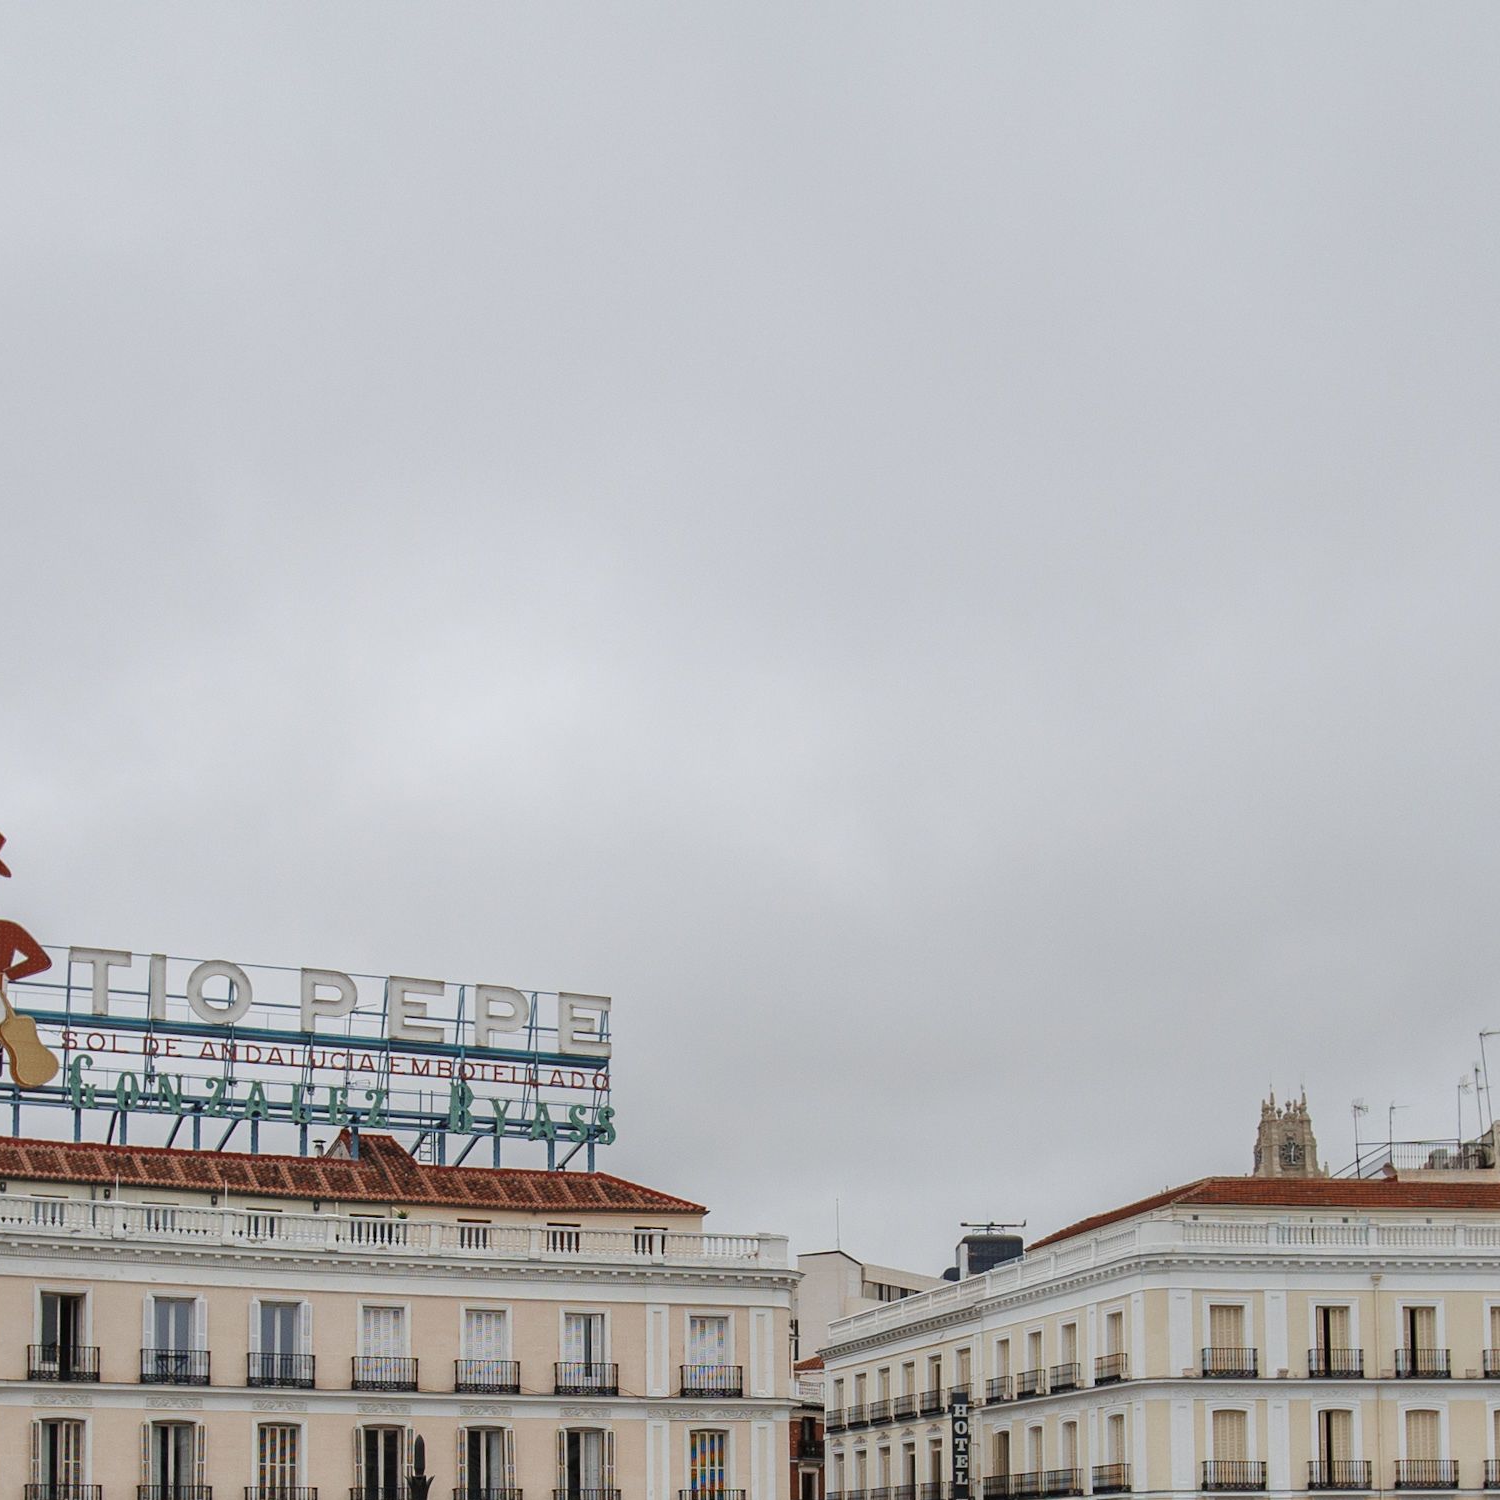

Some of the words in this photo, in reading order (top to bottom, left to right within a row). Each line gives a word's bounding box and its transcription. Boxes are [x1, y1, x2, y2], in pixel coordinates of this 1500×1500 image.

[69, 946, 252, 1024] TIO
[300, 968, 612, 1059] PEPE
[61, 1031, 130, 1053] SOL
[143, 1036, 183, 1058] DE
[389, 1056, 610, 1092] EMBOTELLADO
[69, 1054, 389, 1128] GONZALEZ
[449, 1082, 617, 1146] BYASS
[953, 1404, 969, 1485] HOTEL
